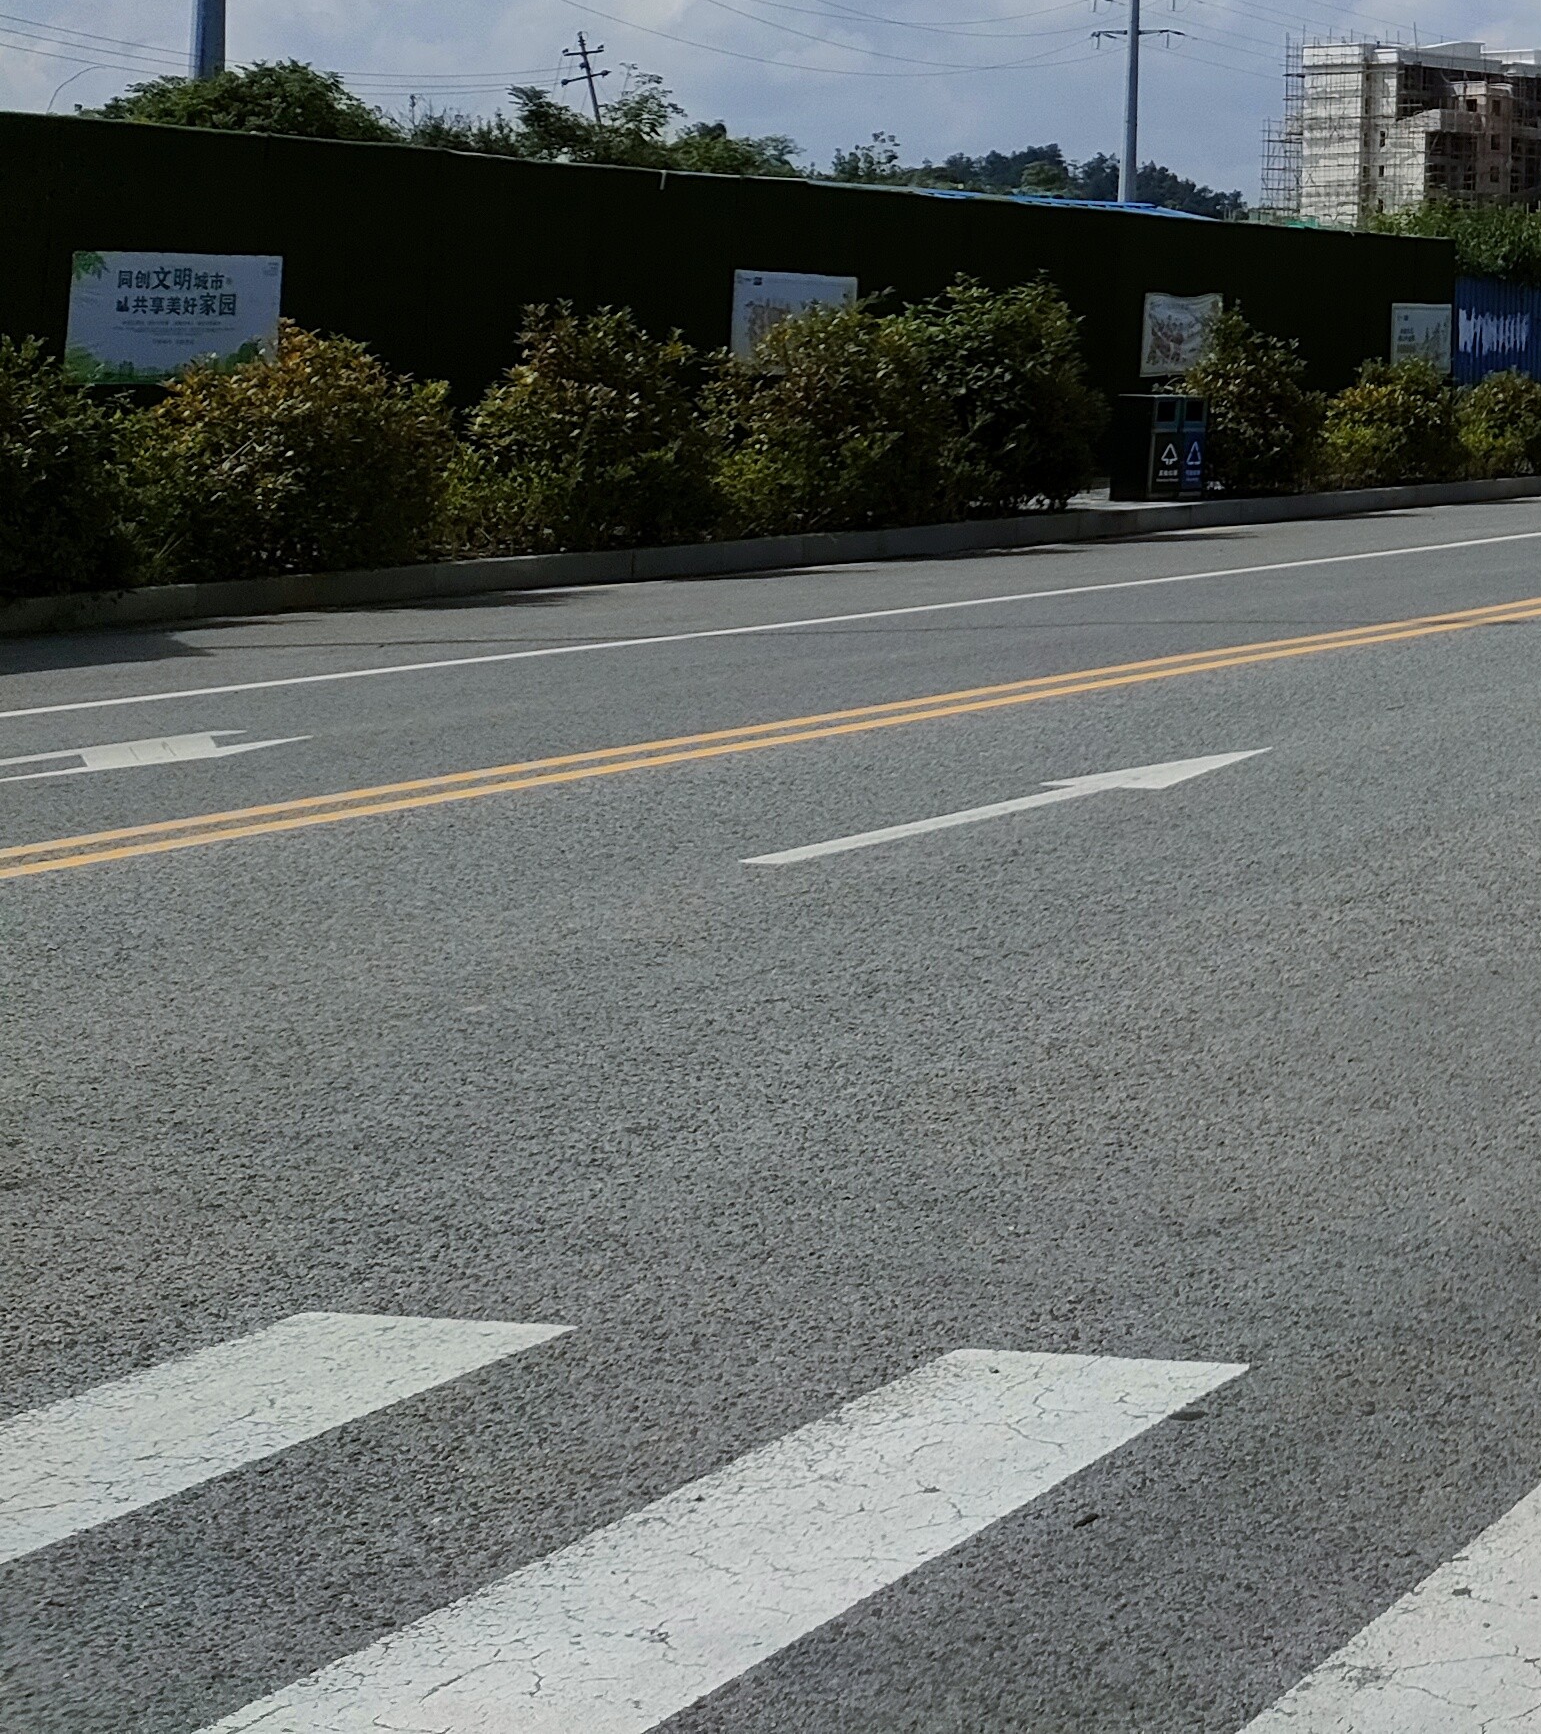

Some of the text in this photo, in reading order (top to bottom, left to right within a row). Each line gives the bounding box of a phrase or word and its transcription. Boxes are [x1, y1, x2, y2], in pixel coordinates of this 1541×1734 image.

[117, 266, 225, 291] 同创文明城市
[131, 292, 237, 316] 共享美好家园
